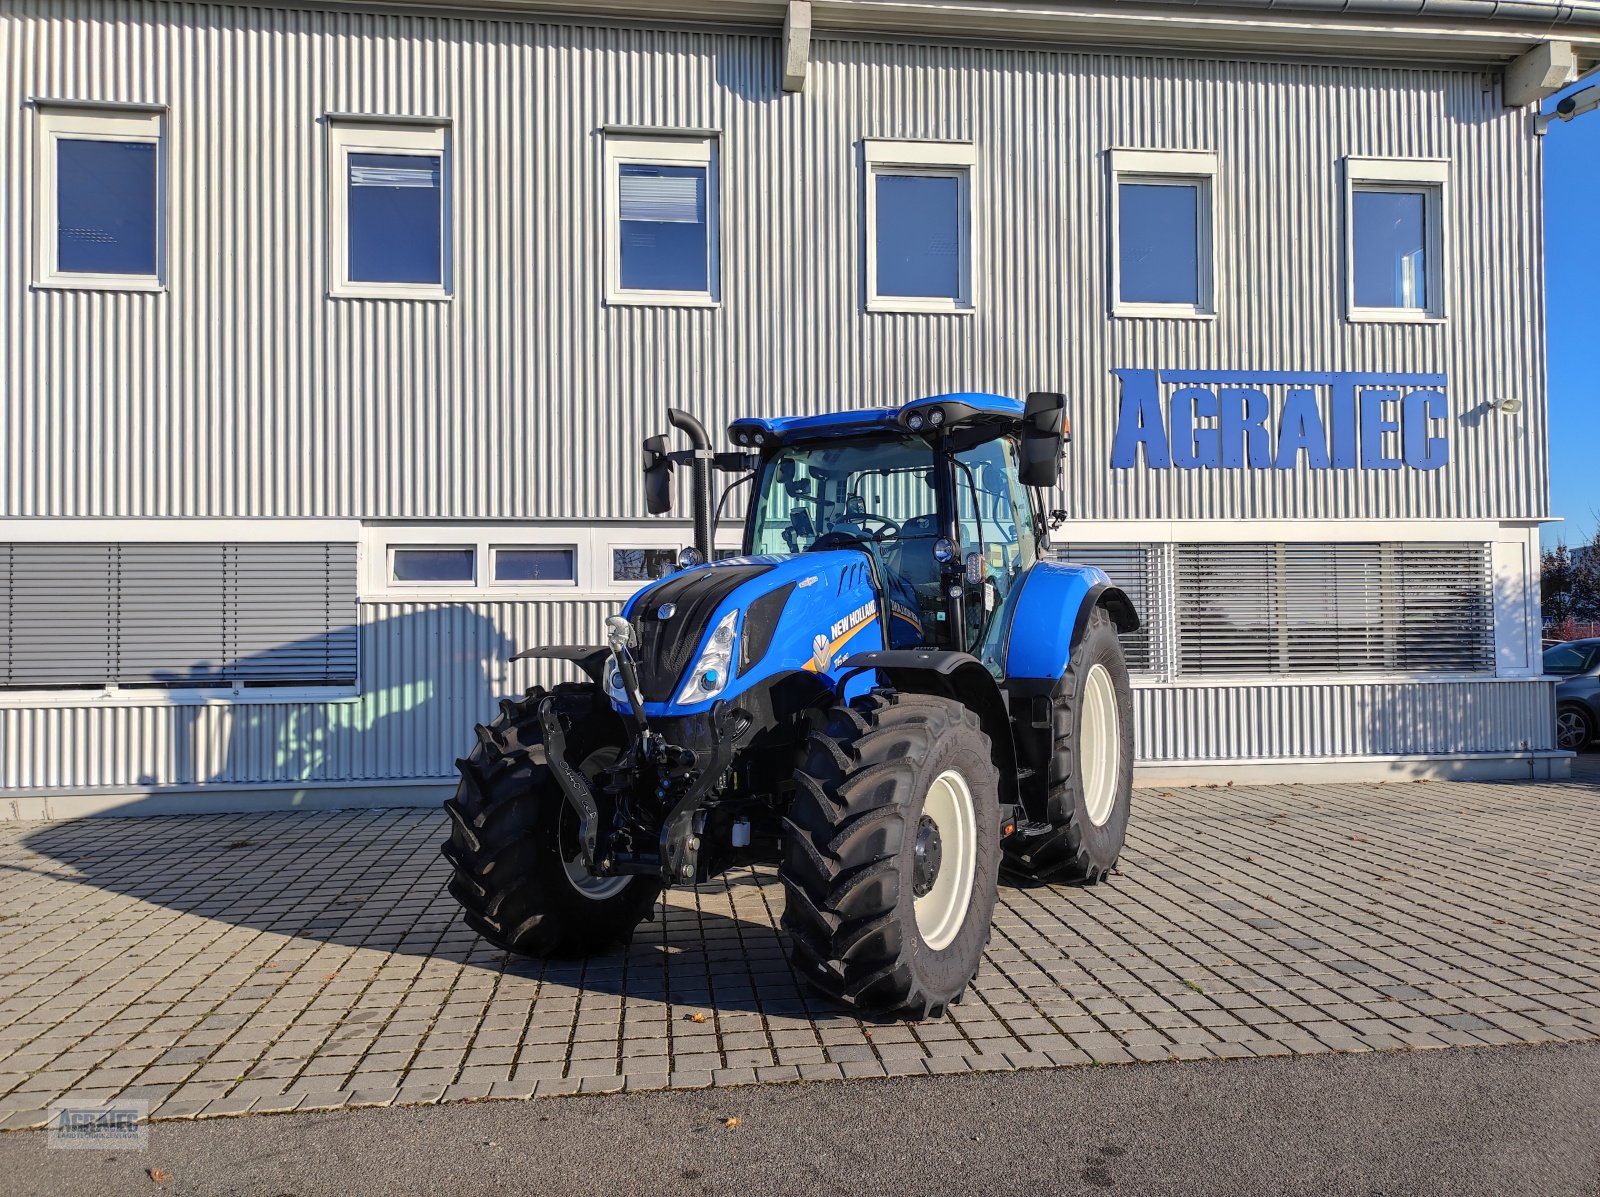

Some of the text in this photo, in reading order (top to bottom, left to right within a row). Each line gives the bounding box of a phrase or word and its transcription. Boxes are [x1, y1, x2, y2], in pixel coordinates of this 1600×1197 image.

[1109, 367, 1448, 470] AGRATEC
[831, 615, 849, 640] NEW
[849, 599, 877, 627] HOLLAND
